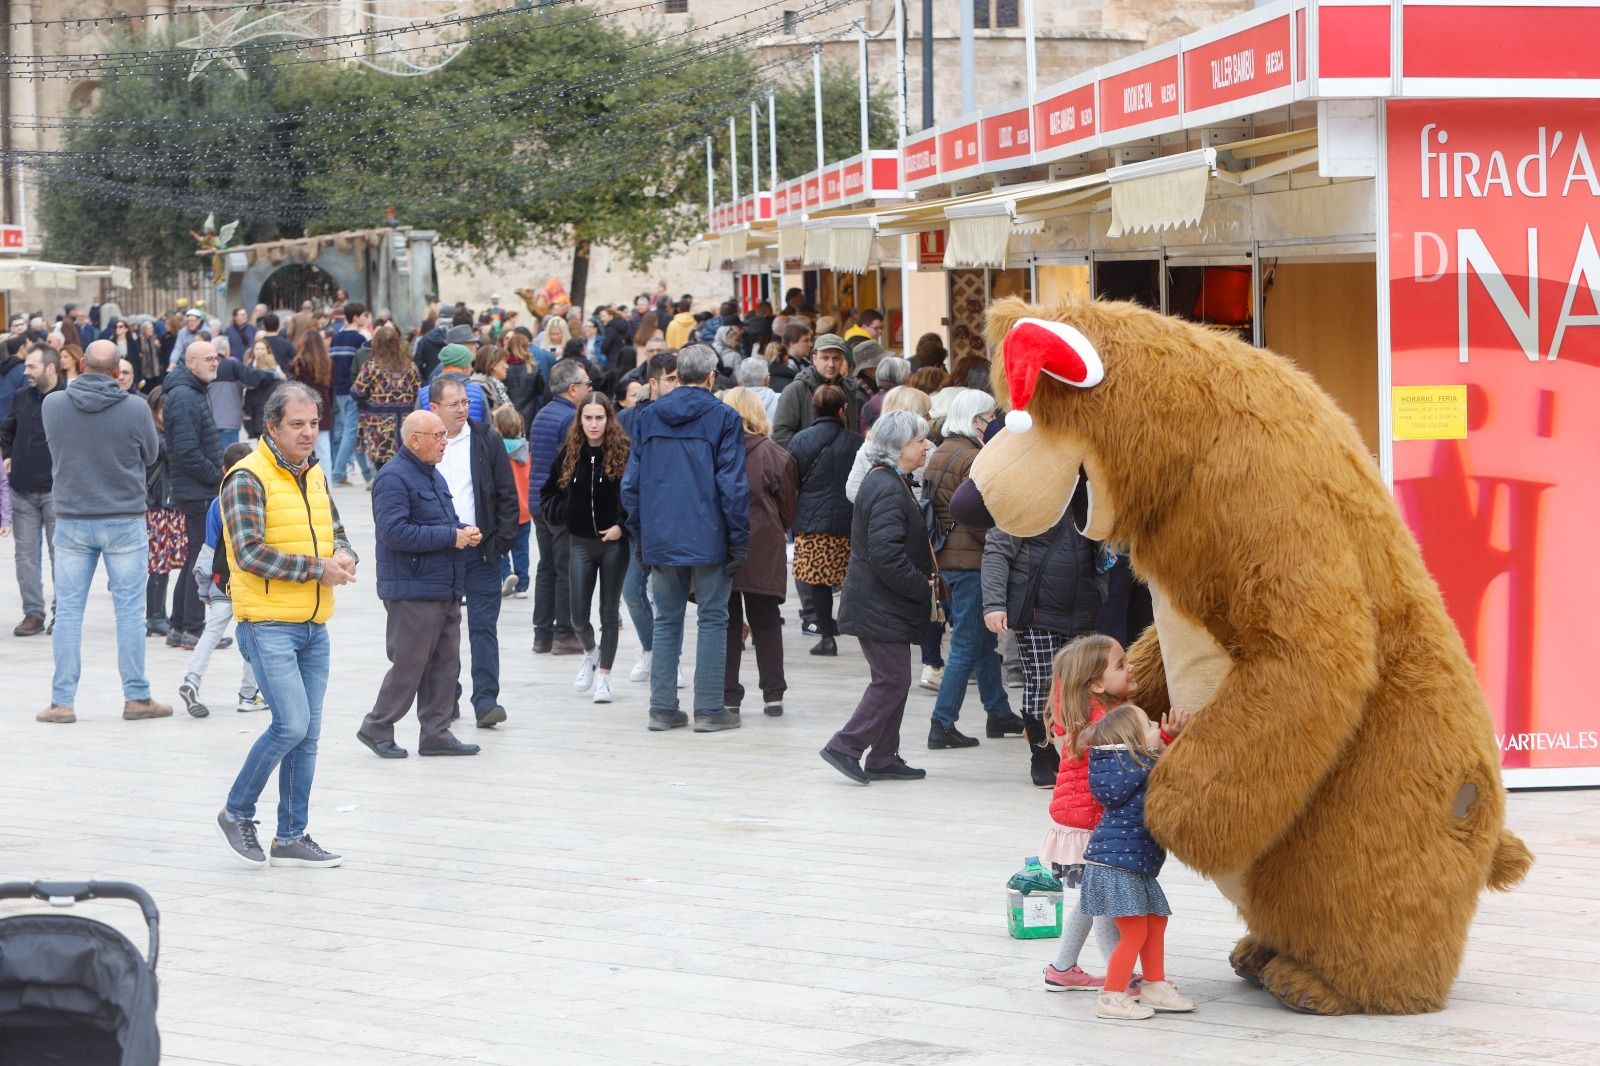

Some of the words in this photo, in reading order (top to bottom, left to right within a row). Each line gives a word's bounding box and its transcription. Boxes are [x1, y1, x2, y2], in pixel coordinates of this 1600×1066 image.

[1210, 55, 1233, 90] TALLER
[1232, 48, 1255, 84] BAMBU
[1265, 49, 1284, 75] HUESCA
[1401, 395, 1433, 403] HORARIO
